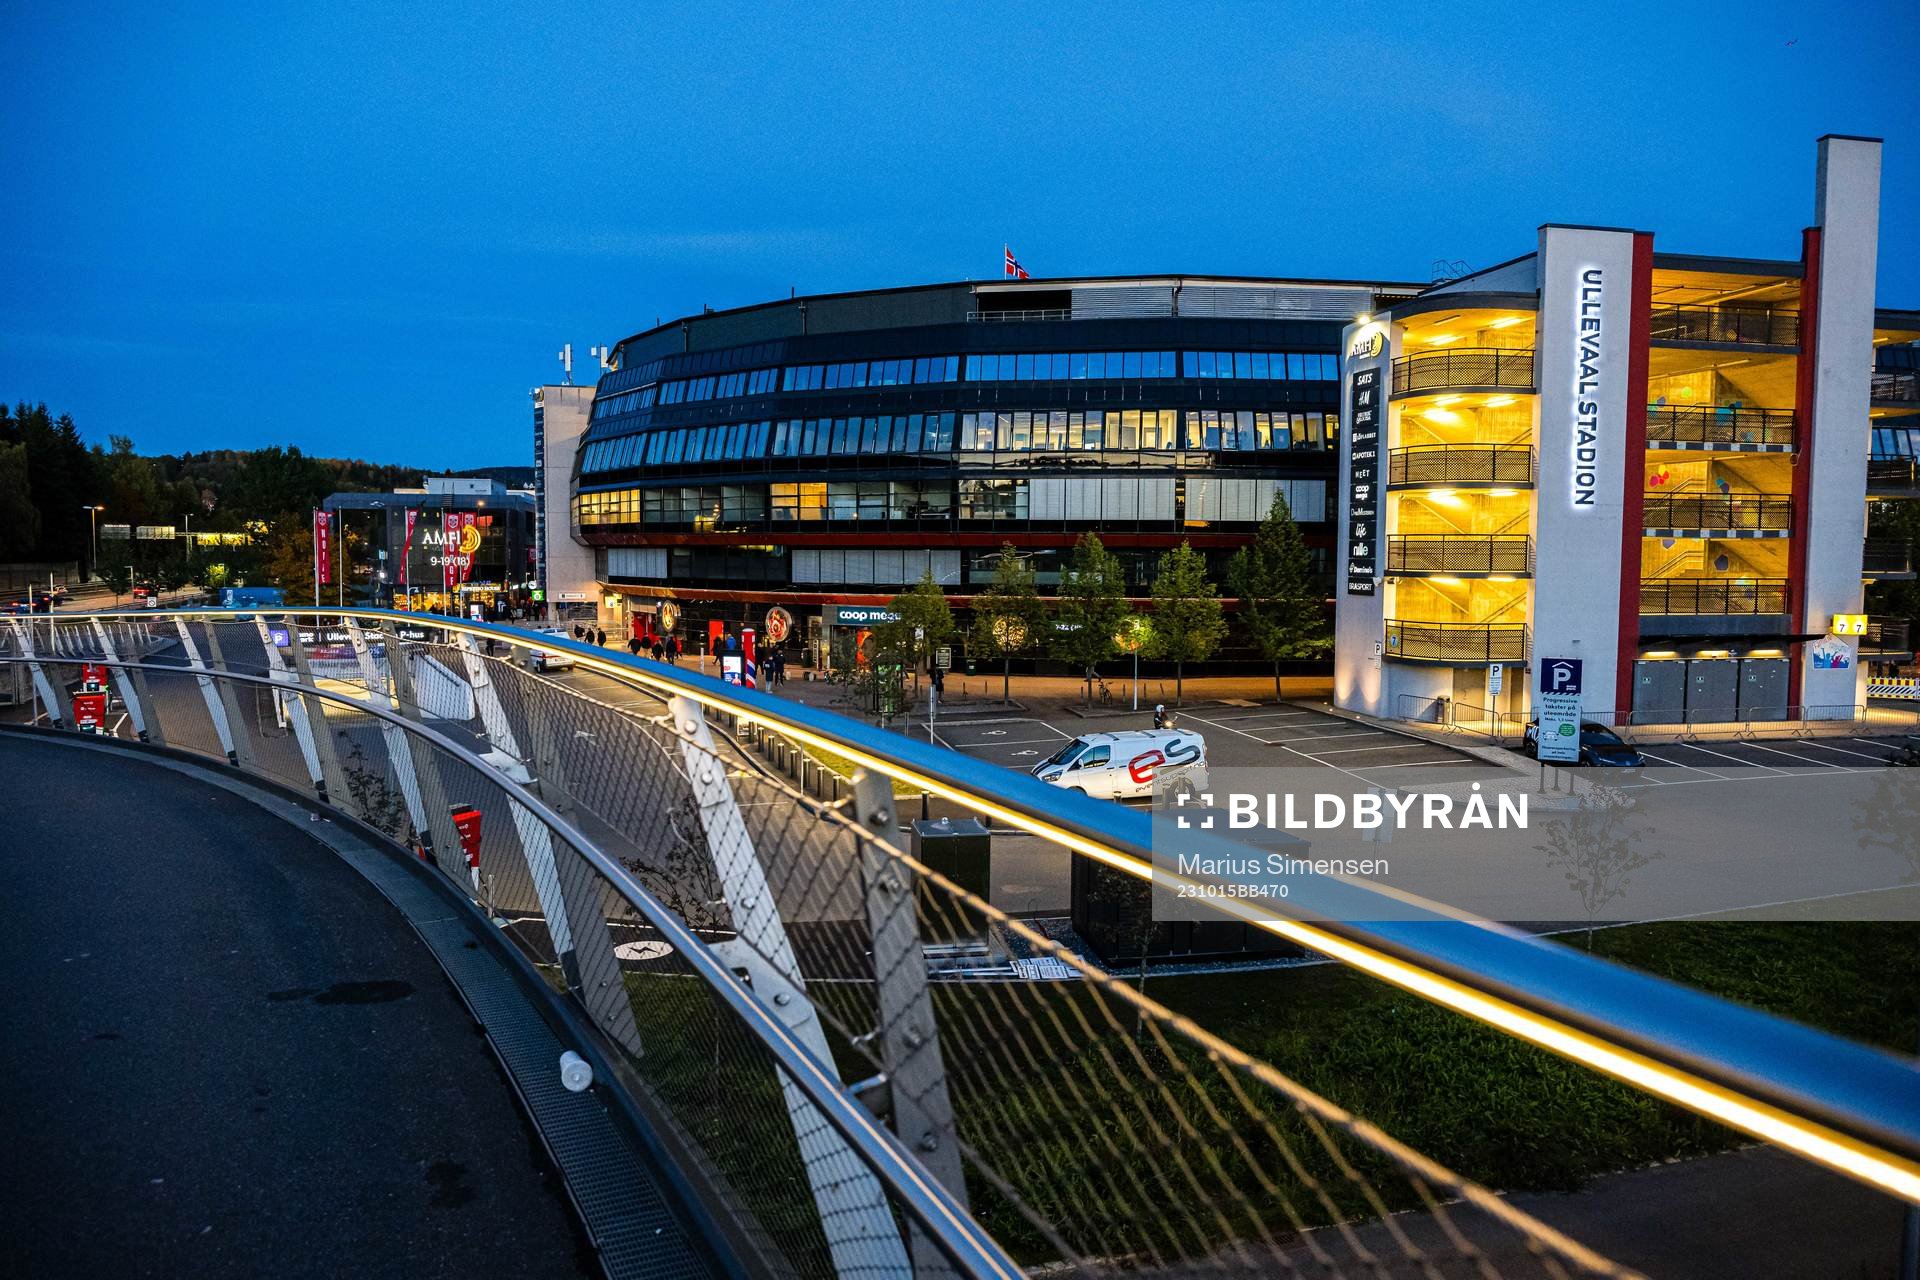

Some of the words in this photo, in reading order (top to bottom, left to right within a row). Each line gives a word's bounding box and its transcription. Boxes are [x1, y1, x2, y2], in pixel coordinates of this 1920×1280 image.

[1579, 269, 1602, 395] ULLEVAAL
[1357, 373, 1373, 386] SATS
[1574, 400, 1598, 506] STADION
[1355, 485, 1370, 494] coop
[422, 529, 462, 545] AMFI
[1353, 542, 1369, 556] nille
[430, 556, 451, 566] 9-19
[1353, 566, 1373, 574] Domino's
[839, 610, 868, 621] coop
[399, 630, 425, 640] P-hus
[1492, 665, 1500, 677] P
[1552, 667, 1572, 690] P
